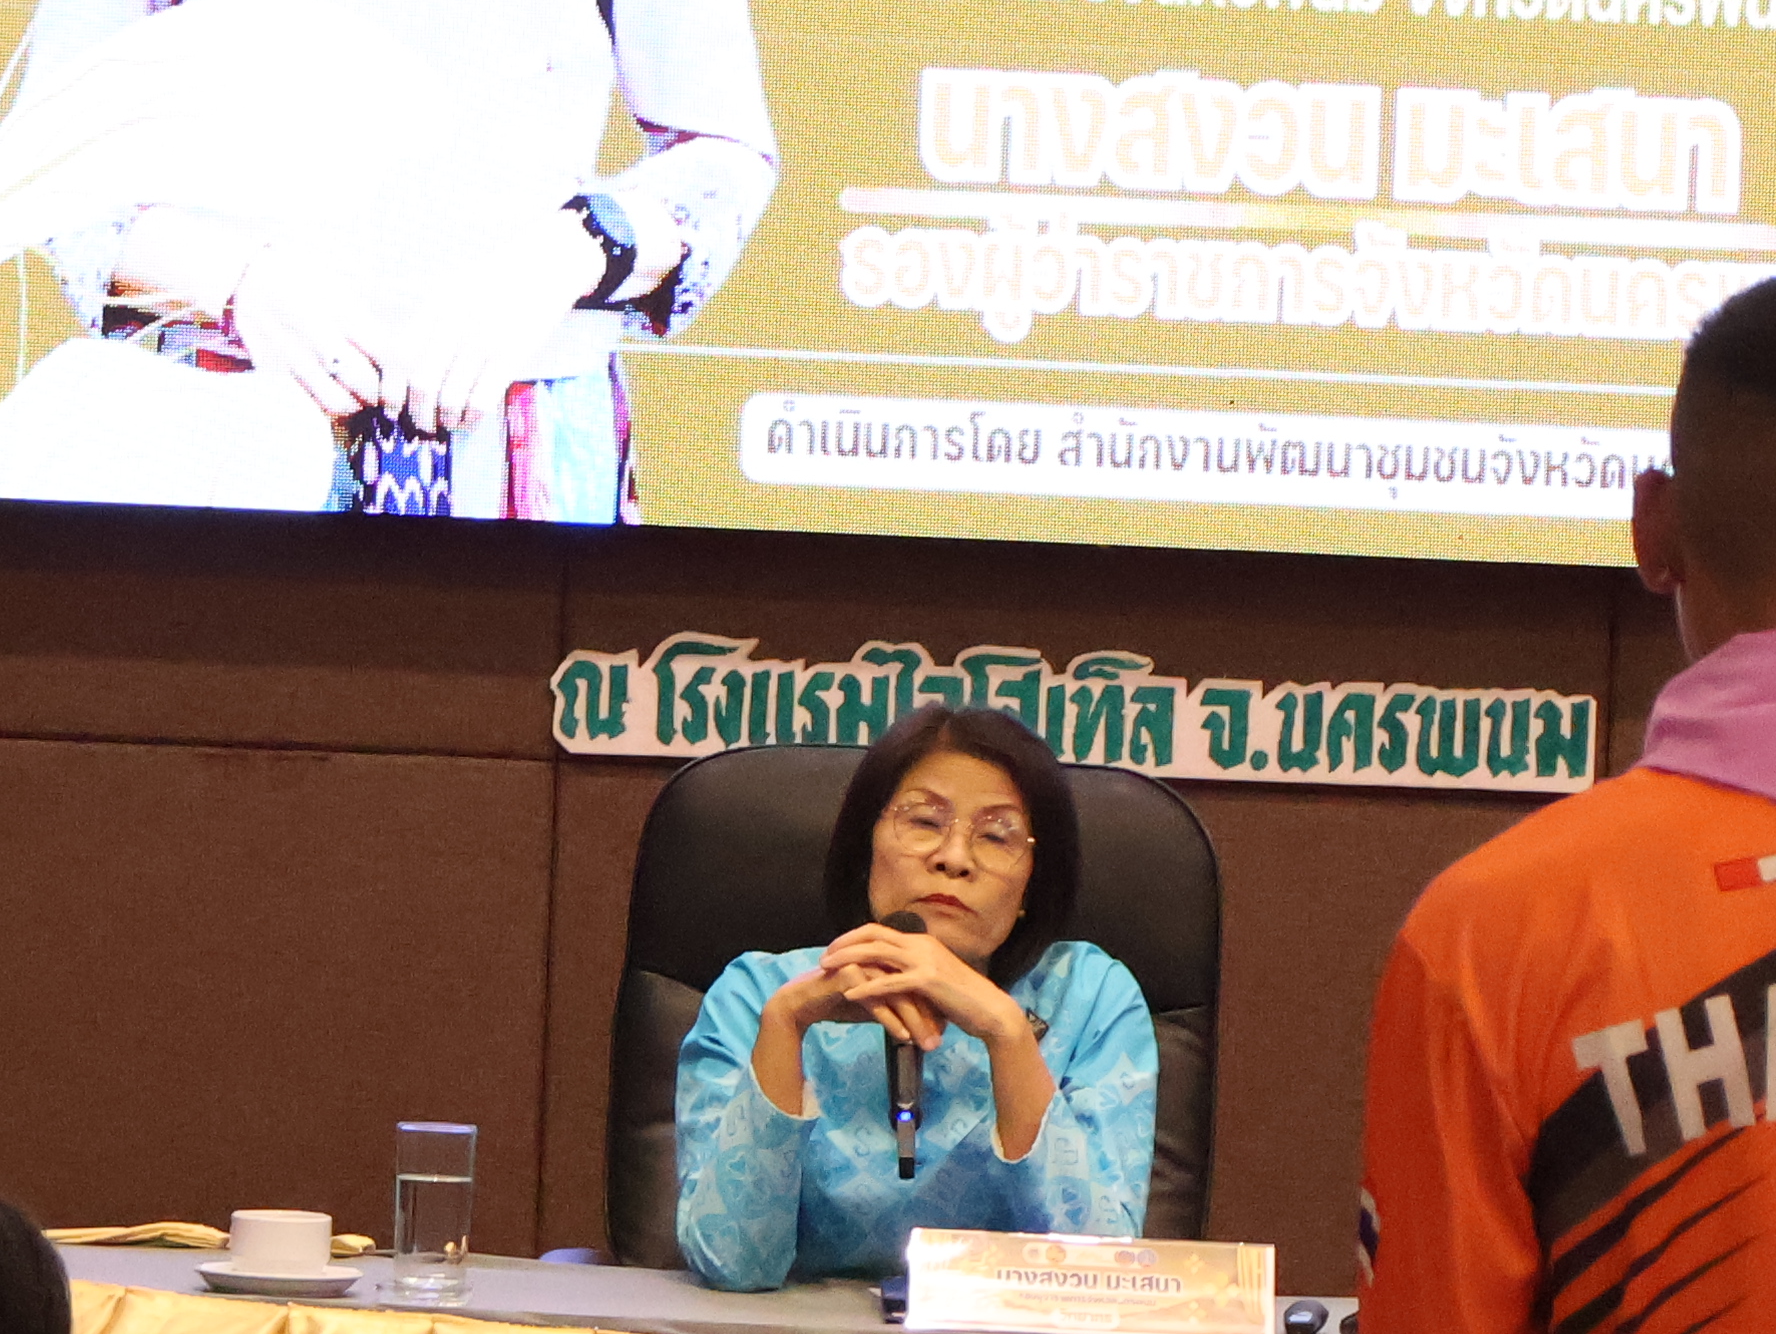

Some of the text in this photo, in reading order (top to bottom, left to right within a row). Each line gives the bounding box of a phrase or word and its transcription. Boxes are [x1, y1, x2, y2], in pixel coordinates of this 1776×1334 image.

[924, 70, 1736, 211] นางสงวน มะเสนา
[767, 399, 1672, 499] ดำเนินการโดย สำนักงานพัฒนาชุมชนจังหวัด
[557, 660, 629, 741] ณ
[1200, 688, 1592, 779] จ.นครพนม
